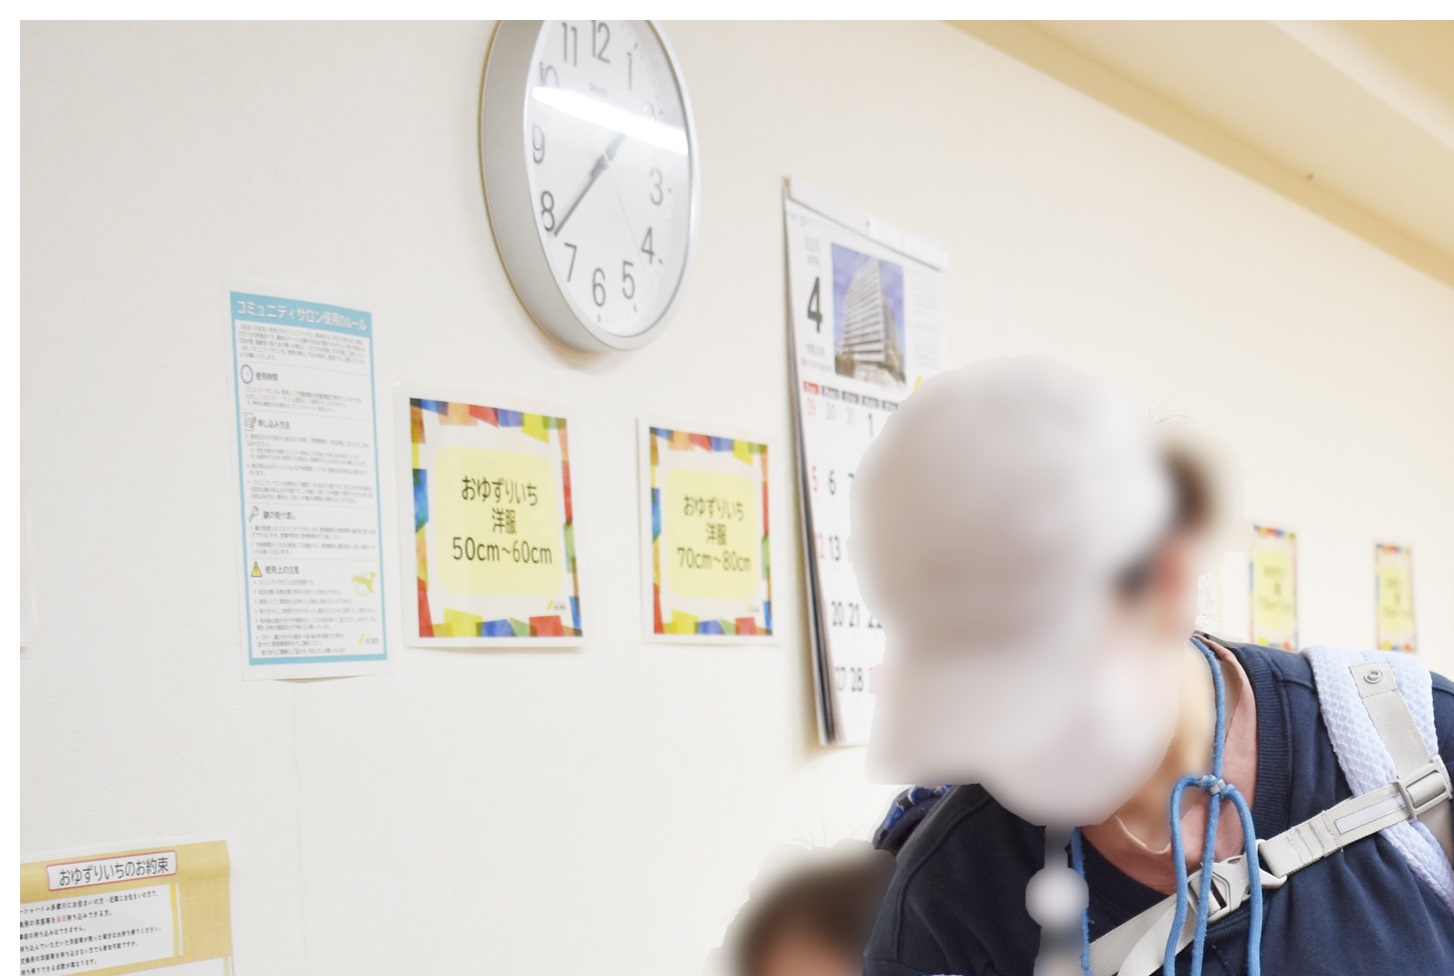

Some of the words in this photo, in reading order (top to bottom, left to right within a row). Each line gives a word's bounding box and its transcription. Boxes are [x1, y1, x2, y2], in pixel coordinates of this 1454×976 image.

[561, 22, 578, 67] 11
[591, 20, 611, 63] 12
[626, 52, 634, 91] 1
[532, 124, 546, 164] 9
[649, 168, 664, 206] 3
[540, 190, 555, 232] 8
[563, 242, 578, 282] 7
[641, 226, 655, 265] 4
[591, 267, 606, 307] 6
[622, 260, 635, 300] 5
[237, 300, 368, 332] コミュニティサロン使用のルール
[807, 276, 823, 333] 4
[868, 413, 874, 438] 1
[461, 475, 539, 506] おゆずりいち
[812, 466, 819, 492] 5
[828, 470, 837, 496] 6
[491, 508, 518, 535] 洋服
[683, 495, 745, 522] おゆずりいち
[706, 522, 729, 547] 洋服
[828, 535, 841, 562] 13
[831, 600, 845, 627] 20
[848, 602, 860, 629] 21
[850, 667, 864, 692] 28
[59, 856, 170, 887] おゆずりいちのお約束
